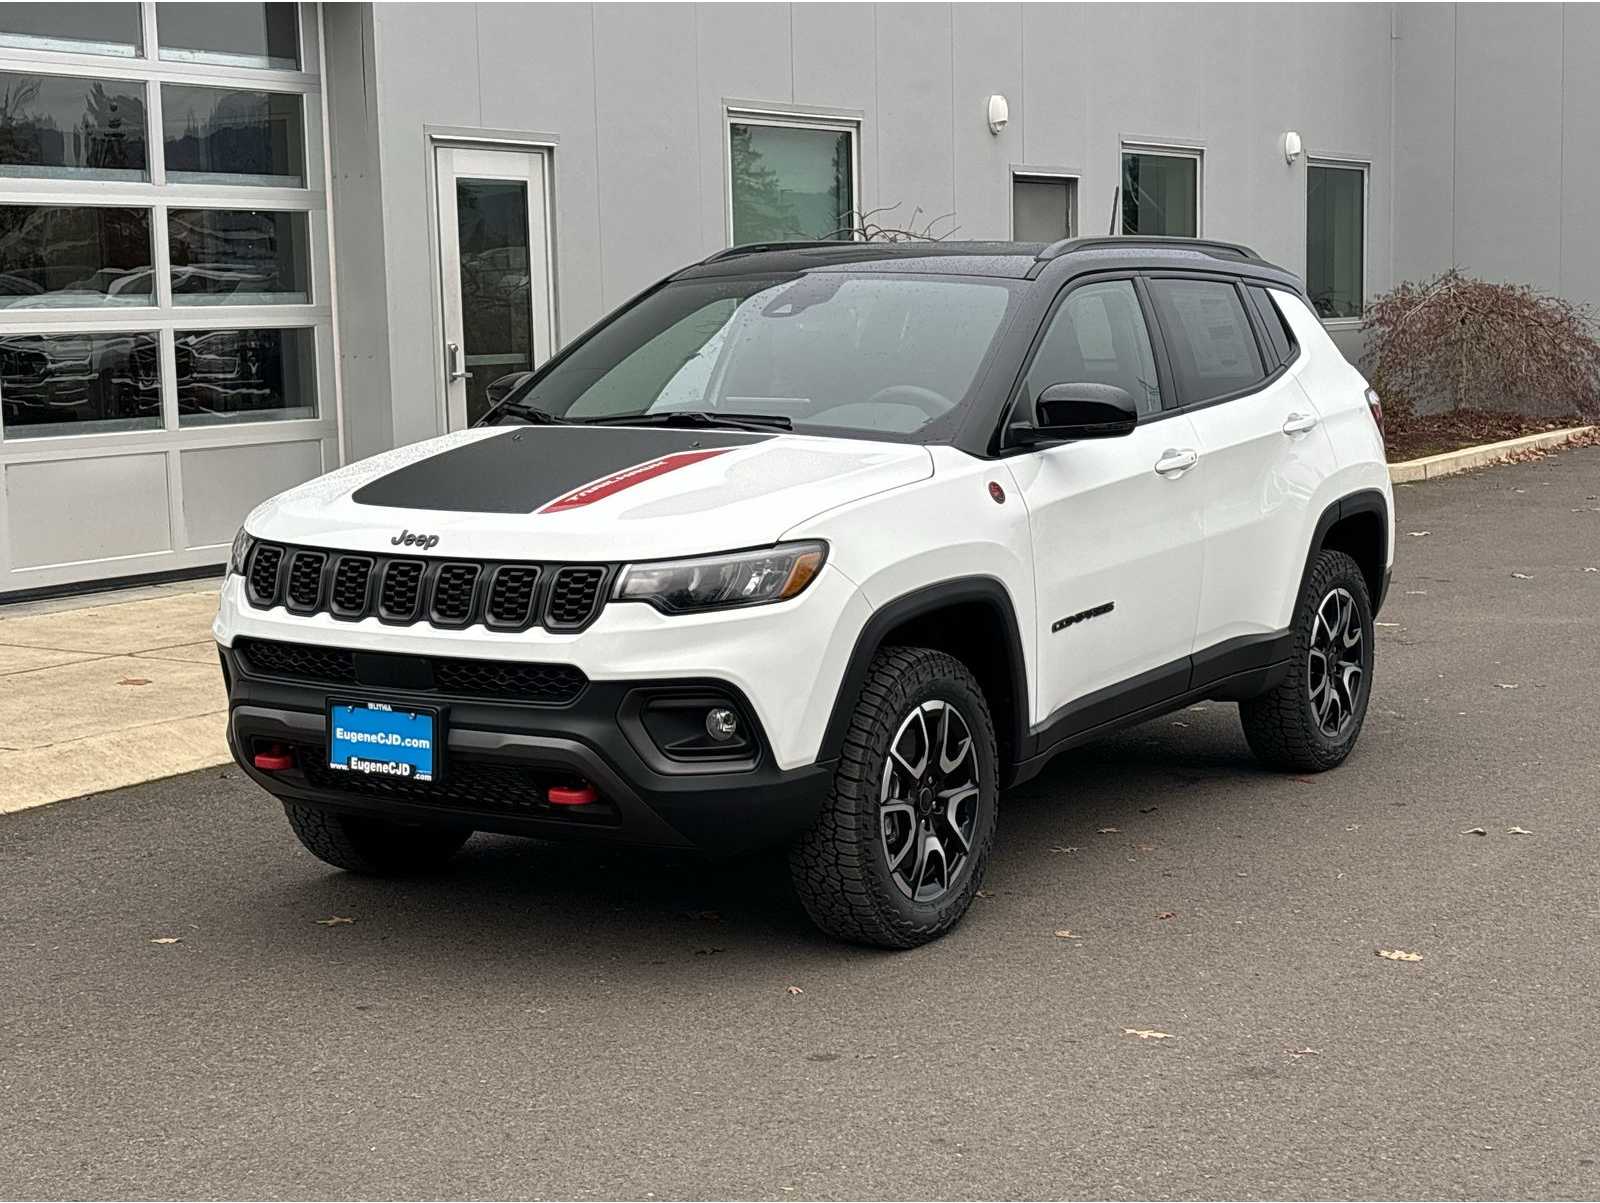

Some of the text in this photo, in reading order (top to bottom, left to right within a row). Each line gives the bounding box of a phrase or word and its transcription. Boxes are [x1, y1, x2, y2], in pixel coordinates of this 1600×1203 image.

[391, 529, 439, 550] Jeep
[336, 727, 430, 749] EugeneCJD.com
[350, 756, 410, 776] EugeneCJD
